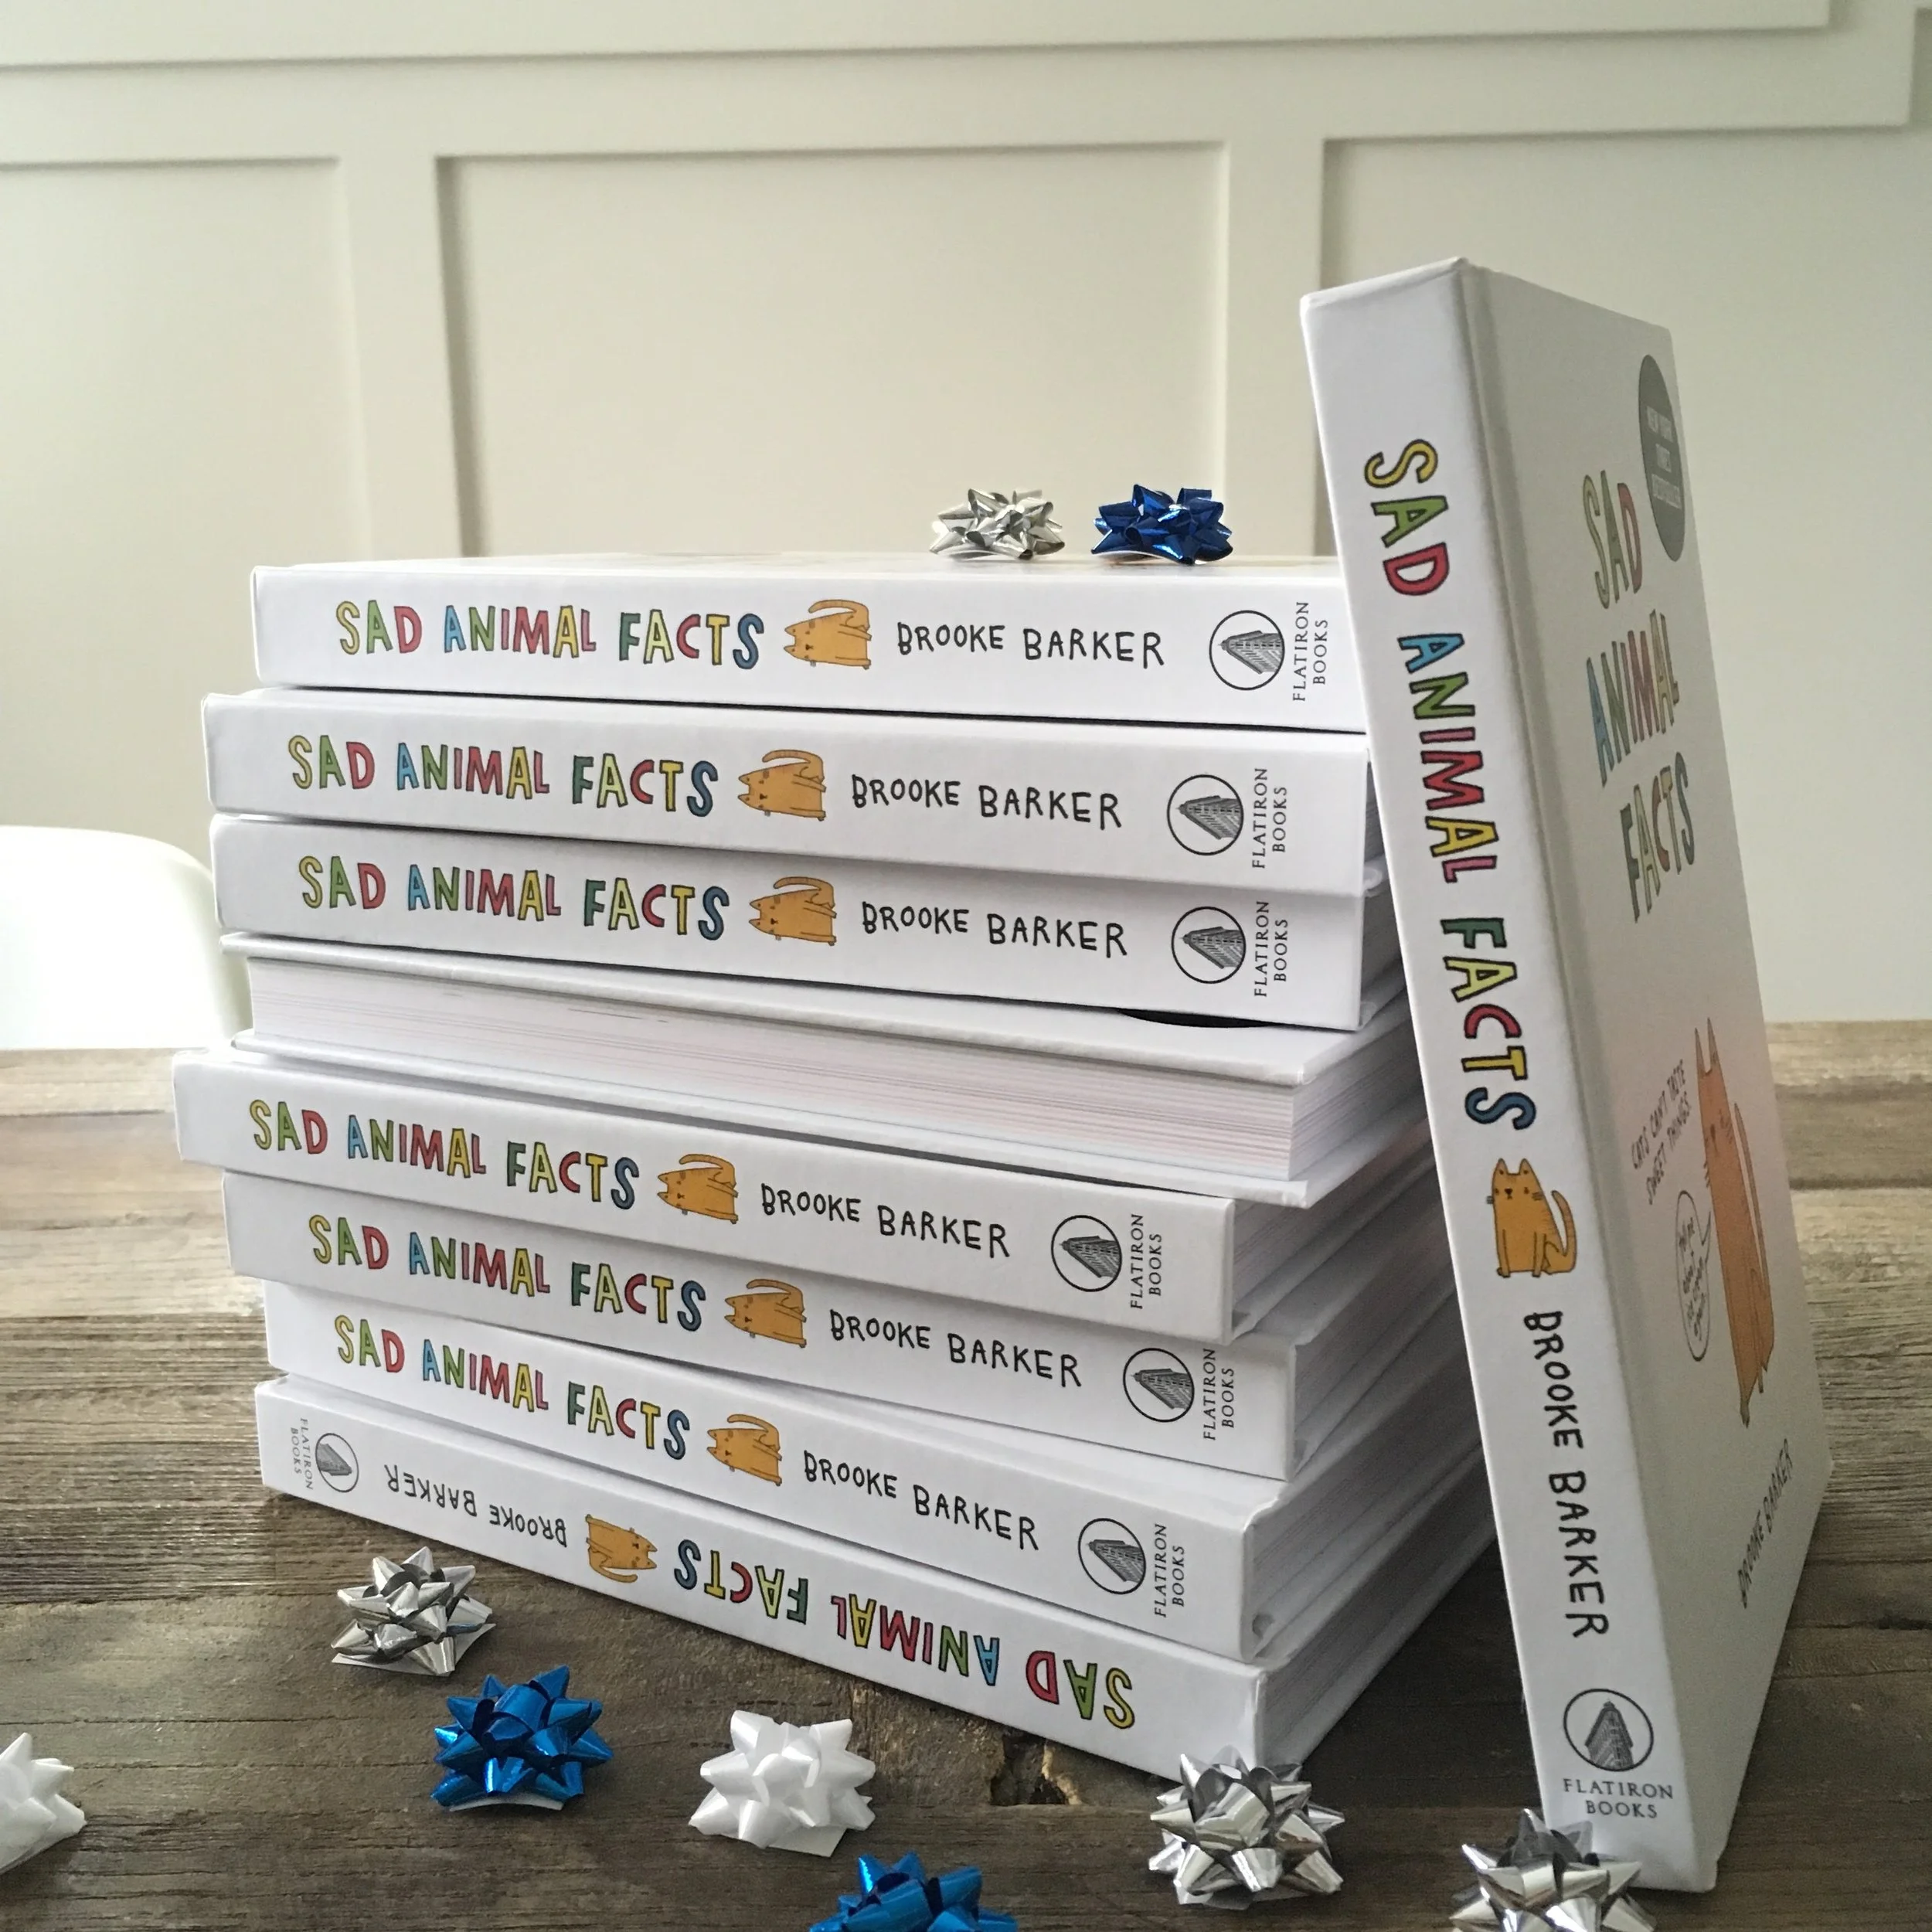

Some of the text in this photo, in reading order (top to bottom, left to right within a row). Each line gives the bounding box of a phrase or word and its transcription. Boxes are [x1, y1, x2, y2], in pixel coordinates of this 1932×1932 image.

[1583, 469, 1643, 609] SAD
[336, 600, 1165, 670] SAD ANIMAL FACTS BROOKE BARKER
[1292, 601, 1309, 702] FLATIRON
[1312, 618, 1328, 685] BOOKS
[1586, 609, 1679, 788] ANIMAL
[288, 735, 1122, 831] SAD ANIMAL FACTS BROOKE BARKER
[1251, 767, 1268, 869] FLATIRON
[1272, 785, 1288, 853] BOOKS
[1619, 751, 1695, 924] FACTS
[299, 855, 1128, 957] SAD ANIMAL FACTS BROOKE BARKER
[1254, 900, 1270, 997] FLATIRON
[1274, 917, 1288, 983] BOOKS
[1364, 439, 1609, 1638] SAD ANIMAL FACTS BROOKE BARKER
[249, 1099, 1010, 1259] SAD ANIMAL FACTS BROOKE BARKER
[308, 1214, 1082, 1388] SAD ANIMAL FACTS BROOKE BARKER
[1130, 1213, 1144, 1309] FLATIRON
[1148, 1233, 1162, 1296] BOOKS
[335, 1315, 1039, 1551] SAD ANIMAL FACTS BROOKE BARKER
[1203, 1348, 1216, 1440] FLATIRON
[1222, 1367, 1235, 1429] BOOKS
[291, 1427, 302, 1474] BOOKS
[300, 1417, 313, 1490] FLATIRON
[383, 1464, 1135, 1729] SAD ANIMAL FACTS BROOKE BARKER
[1154, 1523, 1167, 1618] FLATIRON
[1172, 1545, 1185, 1607] BOOKS
[1563, 1777, 1673, 1800] FLATIRON
[1585, 1799, 1658, 1819] BOOKS
